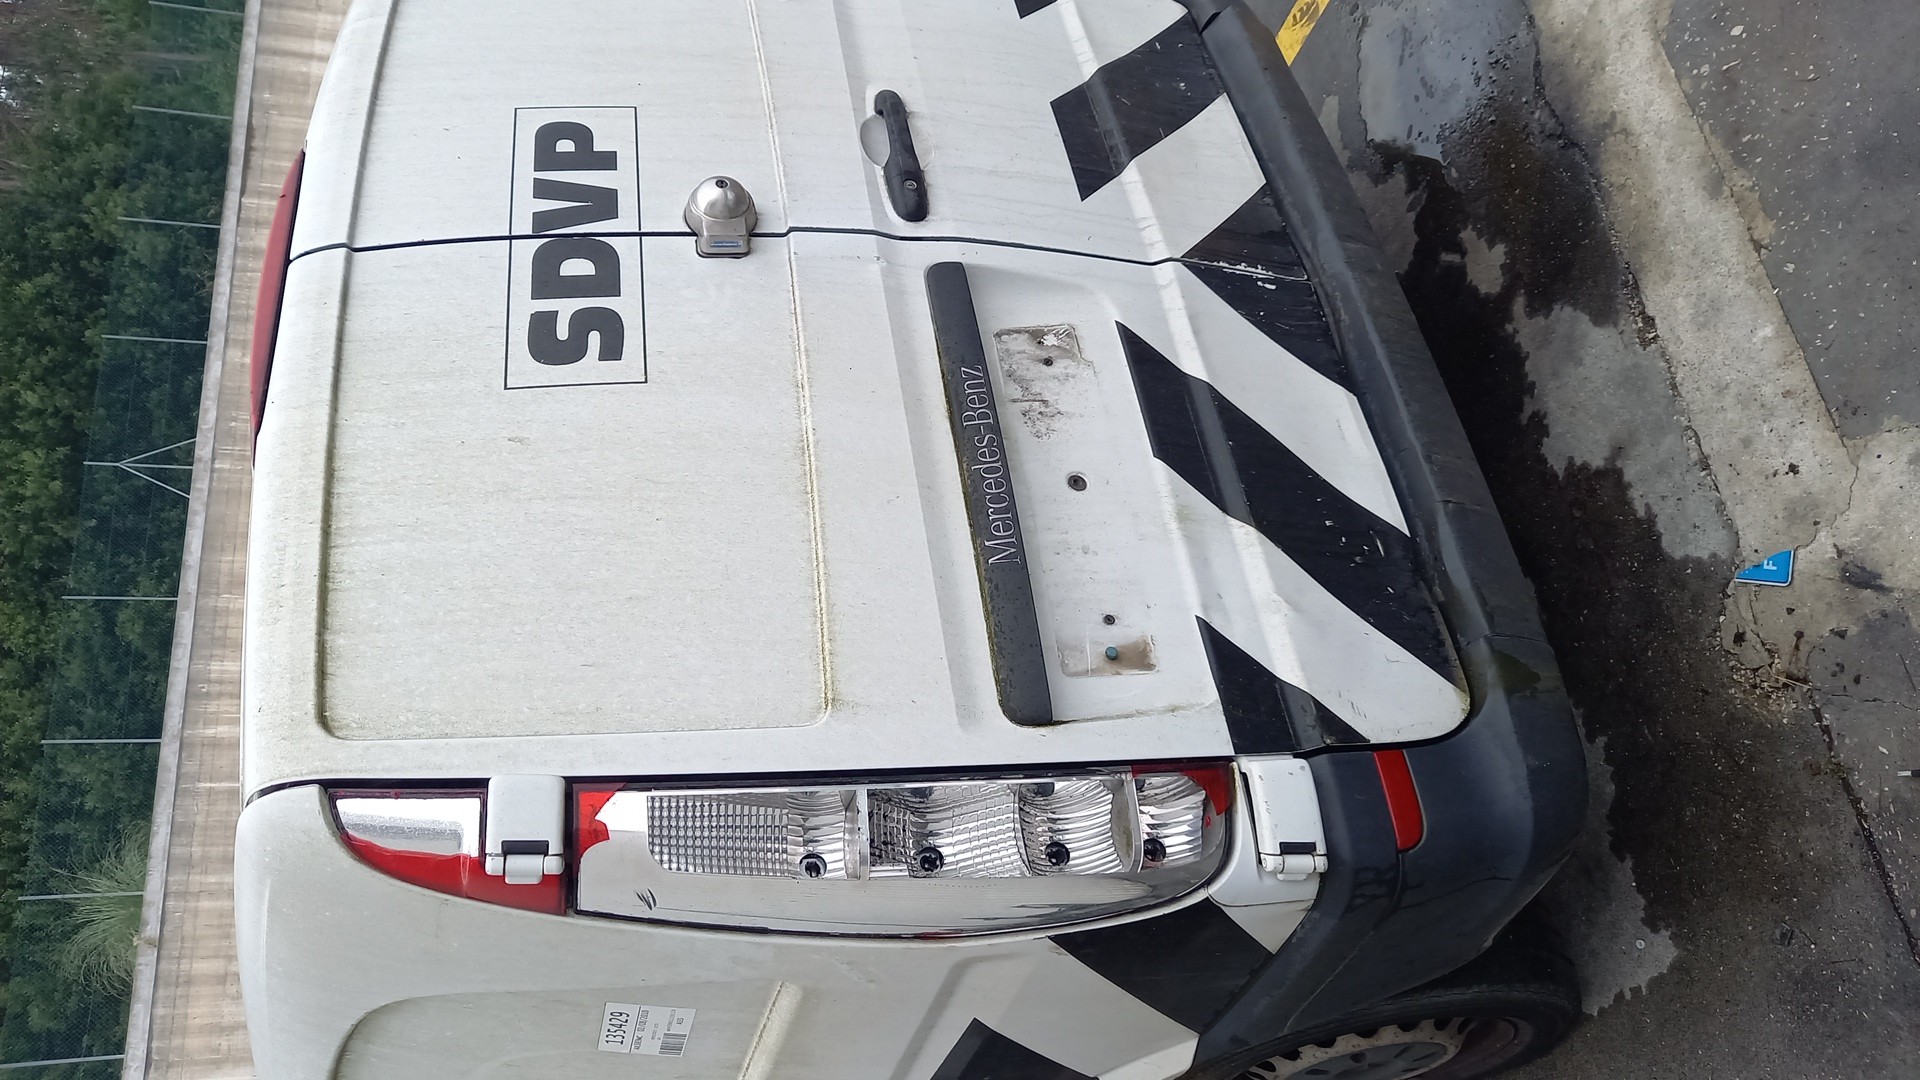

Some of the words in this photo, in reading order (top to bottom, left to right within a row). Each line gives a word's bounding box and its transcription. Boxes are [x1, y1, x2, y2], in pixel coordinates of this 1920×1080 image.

[527, 121, 625, 366] SDVP
[960, 365, 1021, 566] Mercedes-Benz
[1763, 559, 1777, 570] F
[605, 1011, 630, 1045] 135429
